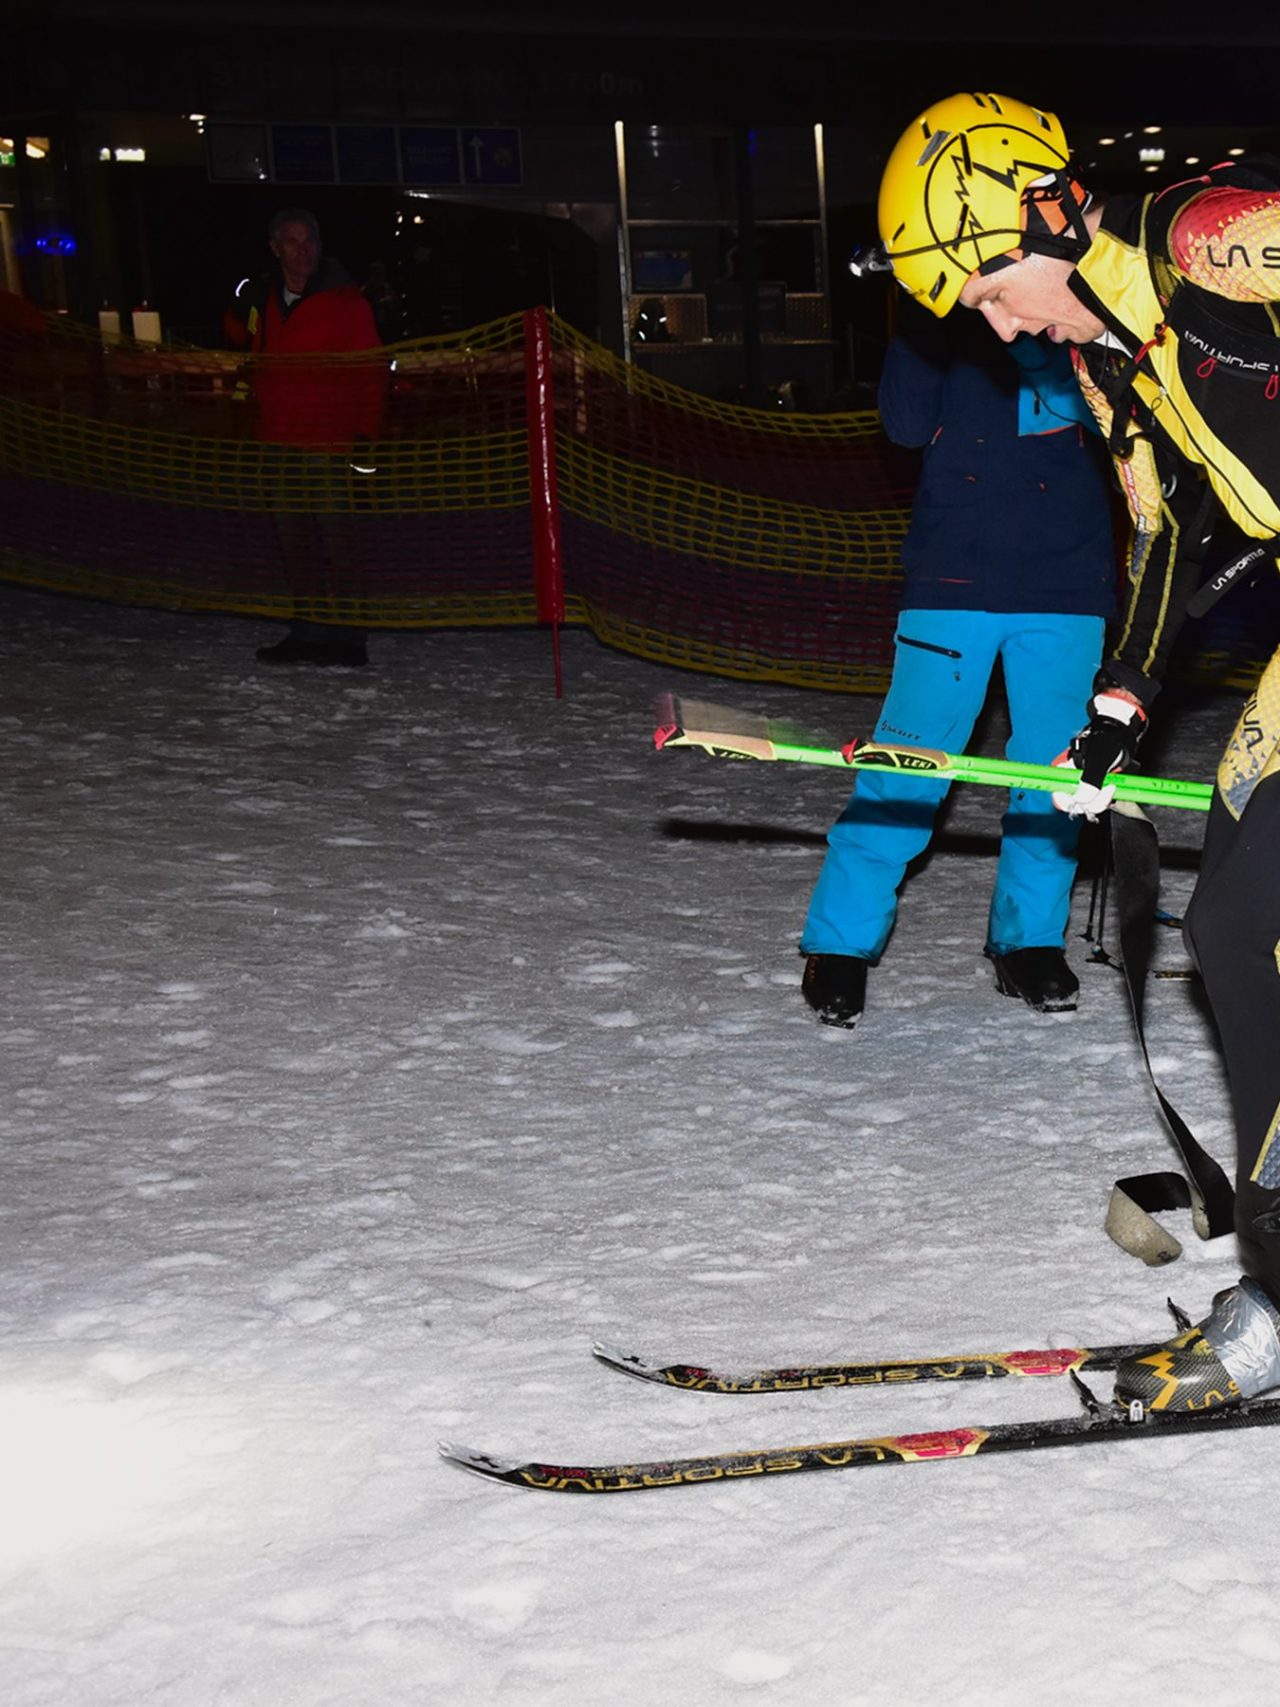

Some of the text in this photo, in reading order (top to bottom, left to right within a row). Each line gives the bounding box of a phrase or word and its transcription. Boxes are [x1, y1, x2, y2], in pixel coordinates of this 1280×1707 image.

[1206, 244, 1251, 268] LA
[1211, 576, 1228, 591] LA
[903, 757, 932, 769] LEKI
[518, 1444, 886, 1491] LA SPORTIVA
